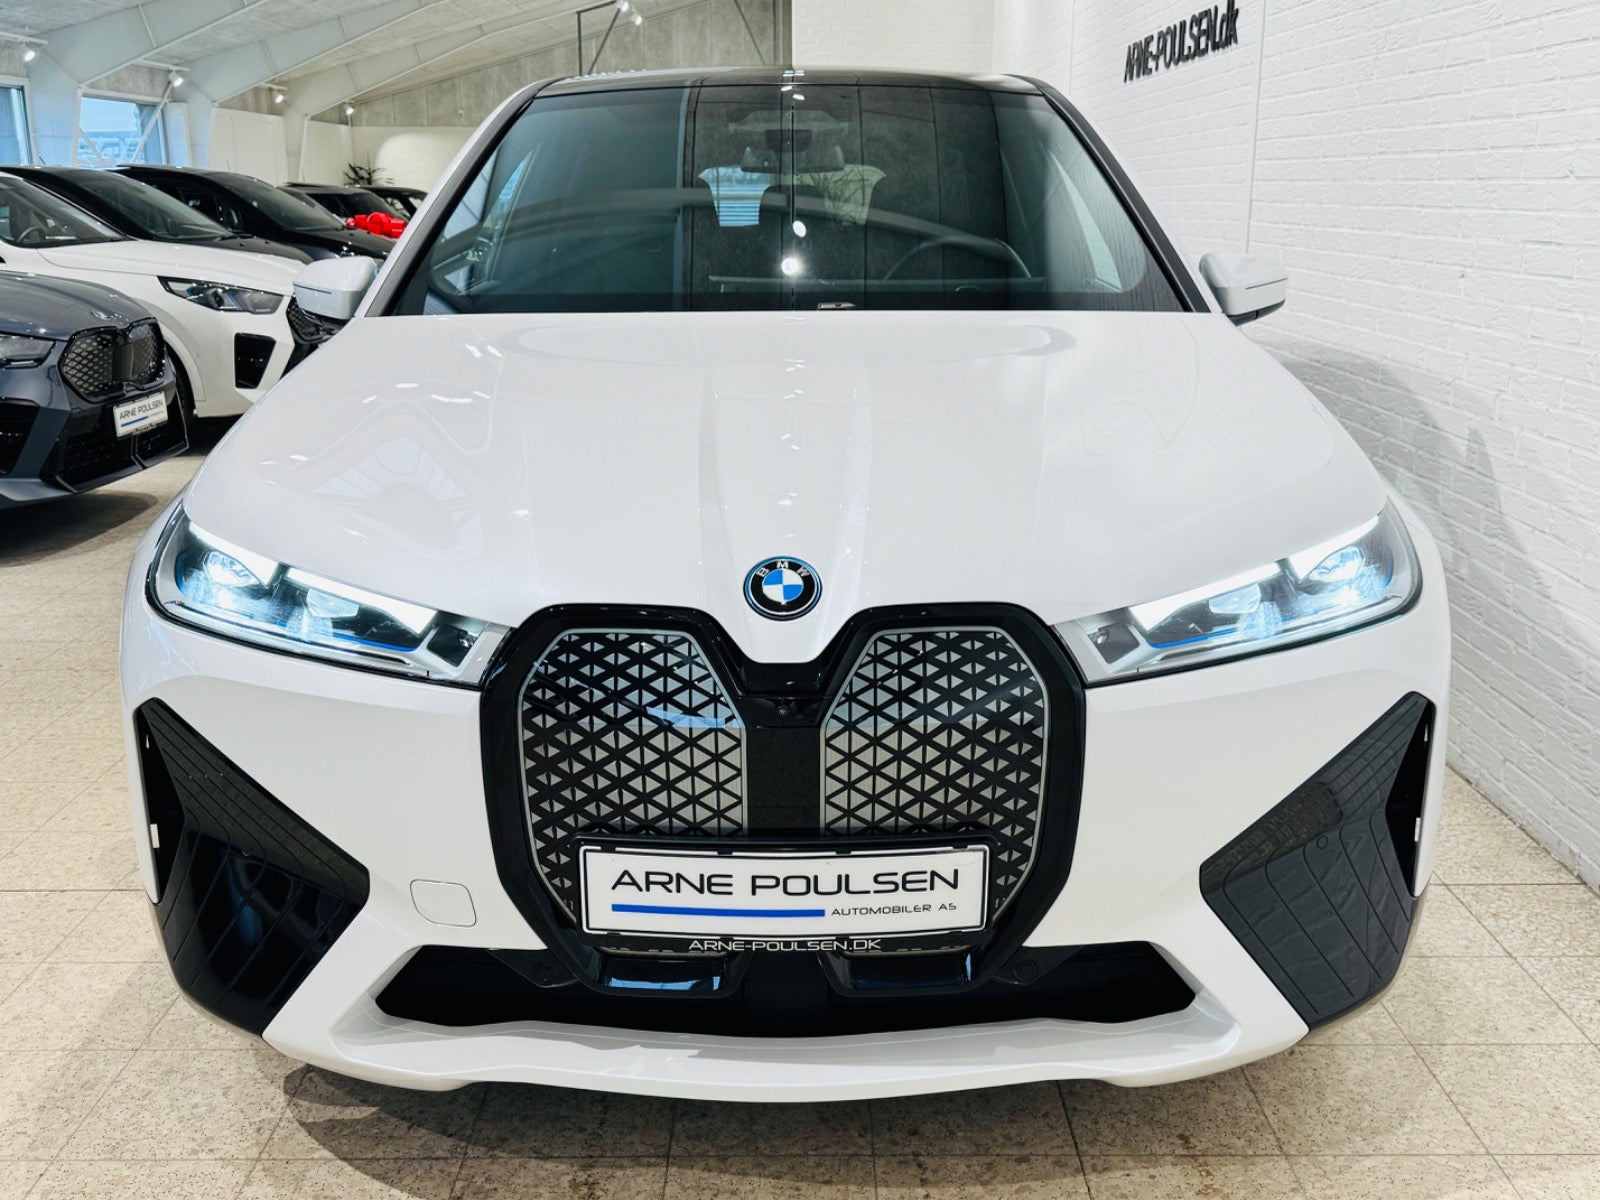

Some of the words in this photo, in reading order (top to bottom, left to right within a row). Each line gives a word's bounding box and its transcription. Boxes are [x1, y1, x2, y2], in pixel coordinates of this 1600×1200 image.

[1124, 0, 1239, 83] ARNE-POULSEN.dk
[756, 560, 811, 577] BMW
[611, 869, 733, 895] ARNE
[751, 868, 959, 896] POULSEN
[831, 903, 932, 916] AUTOMOBILER
[938, 902, 957, 911] AS
[688, 939, 881, 951] ARNE-POULSEN.DK
